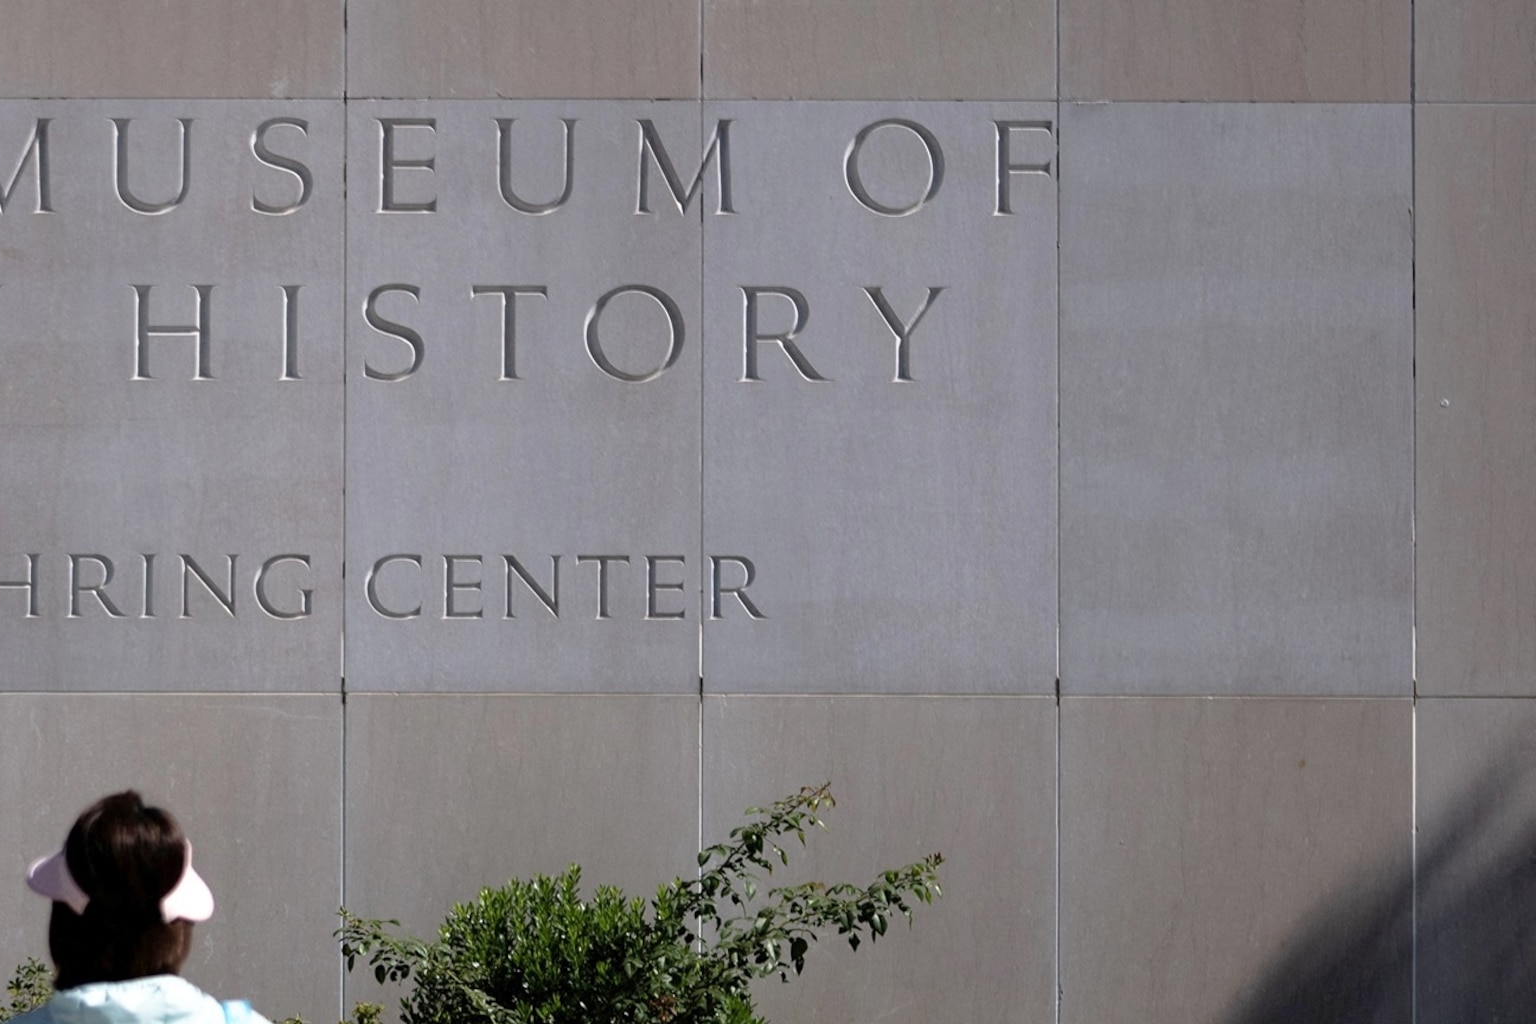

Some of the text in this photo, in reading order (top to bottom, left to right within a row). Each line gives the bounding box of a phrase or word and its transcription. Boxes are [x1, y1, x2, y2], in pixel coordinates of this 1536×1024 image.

[843, 117, 1056, 217] OF
[129, 283, 950, 384] HISTORY
[364, 552, 768, 623] CENTER
